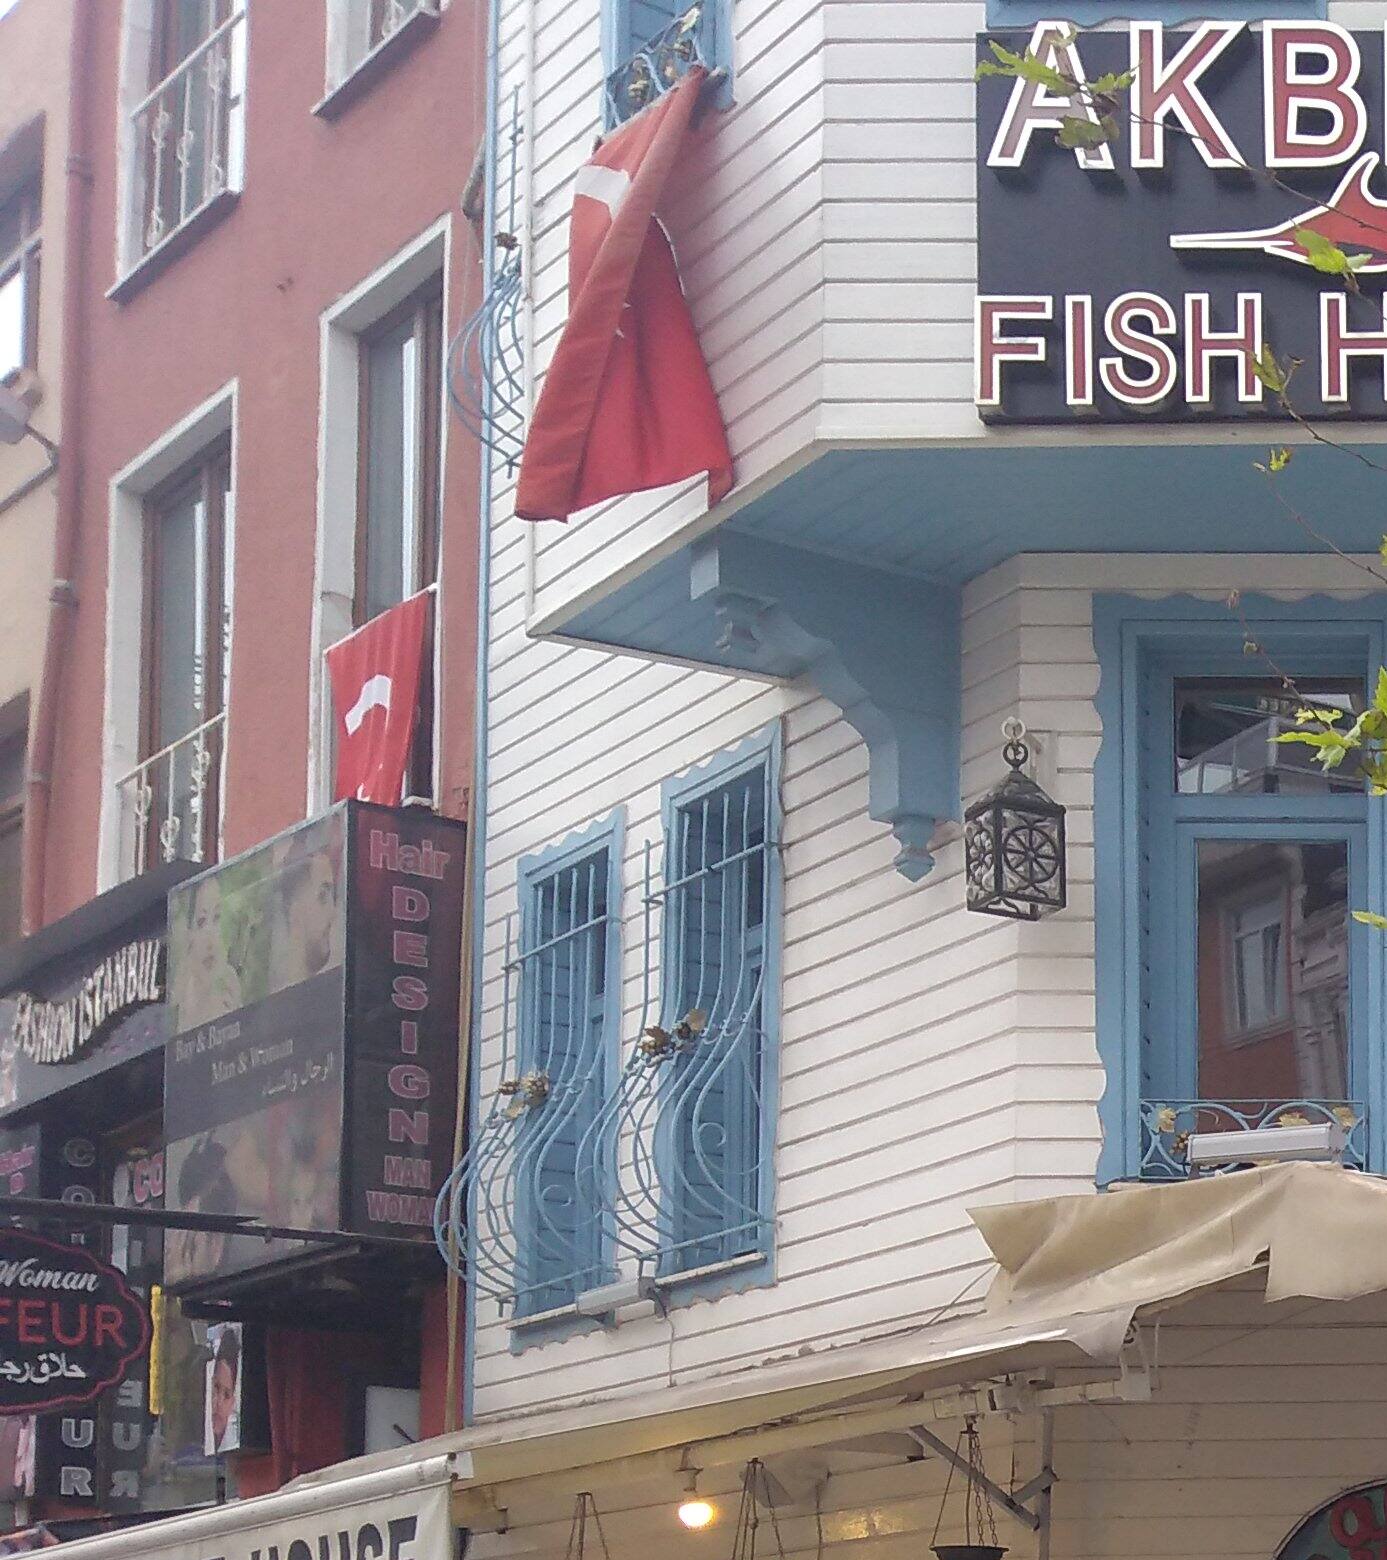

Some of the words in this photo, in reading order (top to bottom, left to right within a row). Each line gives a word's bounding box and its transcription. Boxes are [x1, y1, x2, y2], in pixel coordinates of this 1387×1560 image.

[973, 289, 1266, 408] FISH
[368, 829, 451, 881] Hair
[388, 885, 431, 1145] DESIGN
[382, 1154, 431, 1190] MAN
[365, 1189, 440, 1226] WOMA
